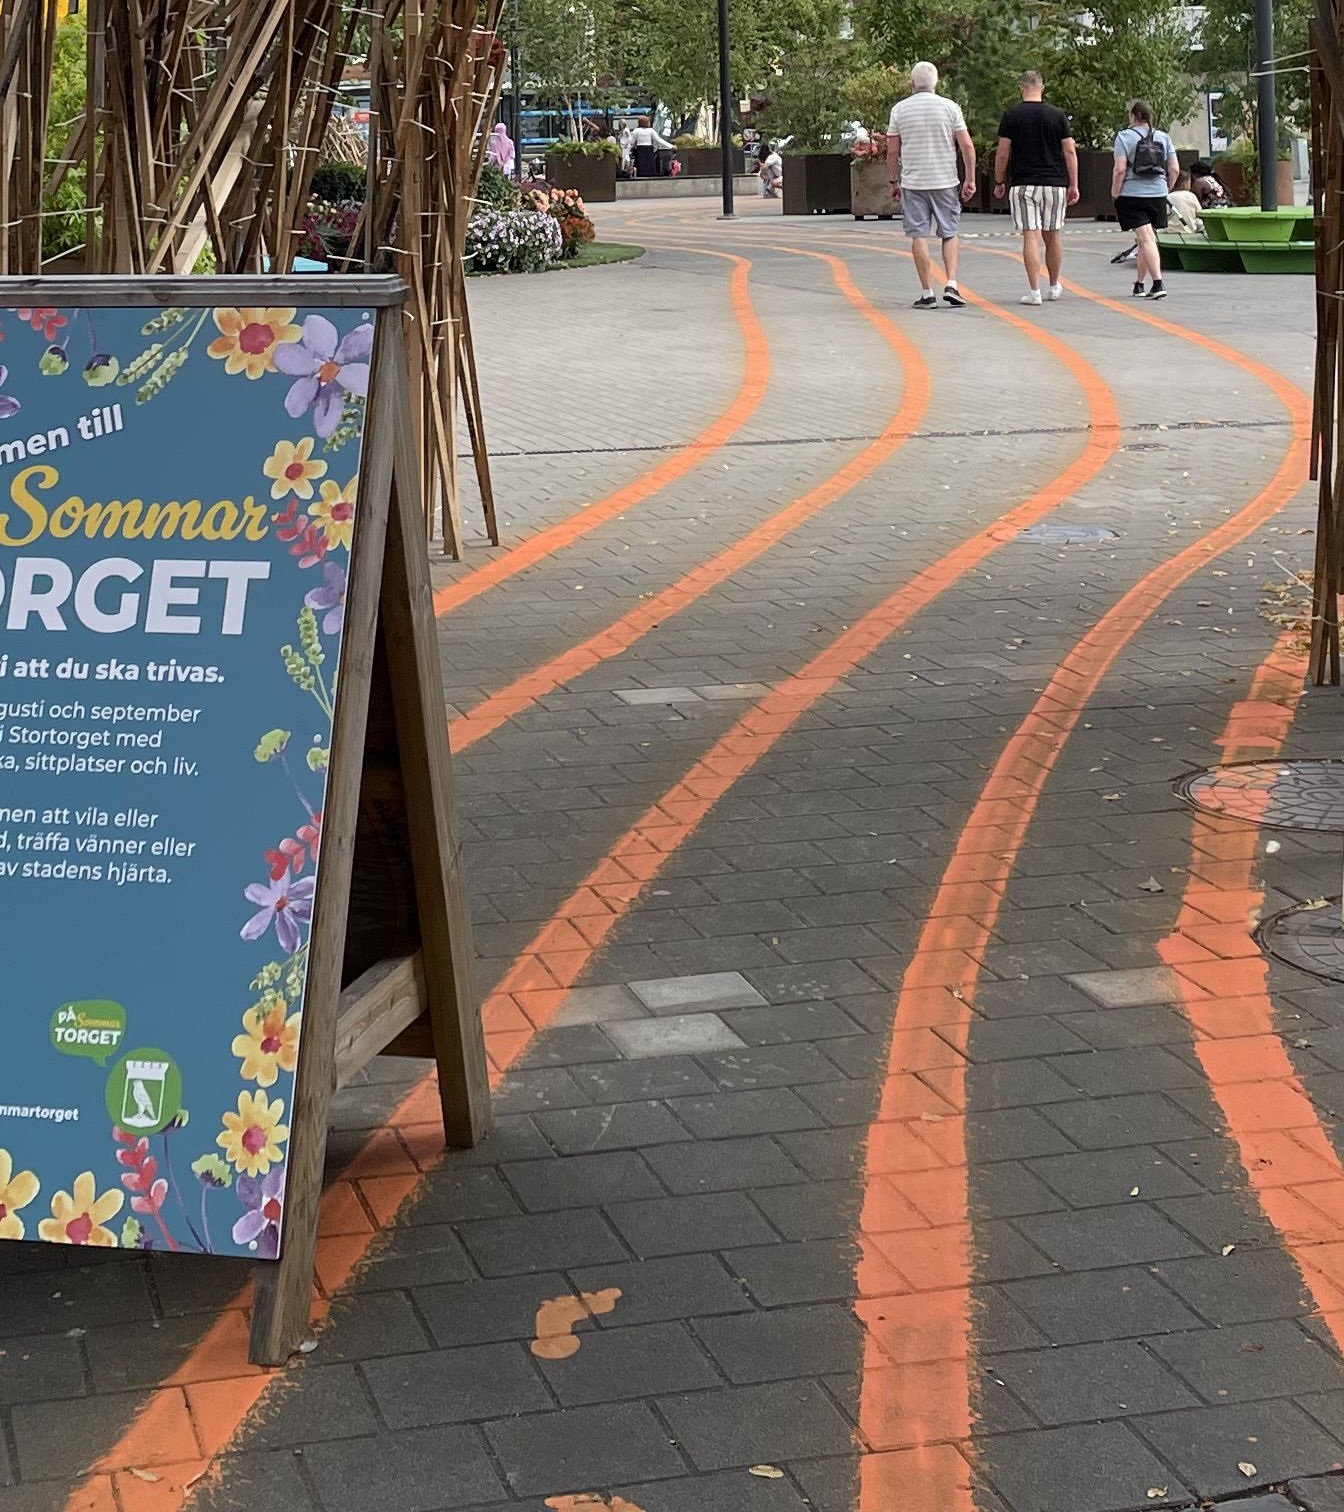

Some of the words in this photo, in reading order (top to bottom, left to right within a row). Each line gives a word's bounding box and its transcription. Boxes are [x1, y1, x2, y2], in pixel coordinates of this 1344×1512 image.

[77, 403, 124, 442] till
[13, 657, 50, 680] att
[56, 657, 90, 680] du
[94, 658, 140, 682] ska
[147, 659, 226, 684] trivas.
[49, 701, 86, 720] och
[90, 702, 202, 728] september
[8, 726, 112, 749] Stortorget
[116, 729, 164, 749] med
[24, 752, 125, 776] sittplatser
[130, 756, 167, 776] och
[173, 757, 200, 777] liv.
[41, 807, 70, 825] att
[74, 807, 109, 827] vila
[113, 809, 159, 828] eller
[16, 830, 71, 852] träffa
[74, 834, 147, 855] vänner
[150, 836, 197, 857] eller
[21, 860, 103, 880] stadens
[106, 861, 173, 885] hjärta.
[58, 1006, 76, 1023] PÅ
[55, 1027, 121, 1045] TORGET
